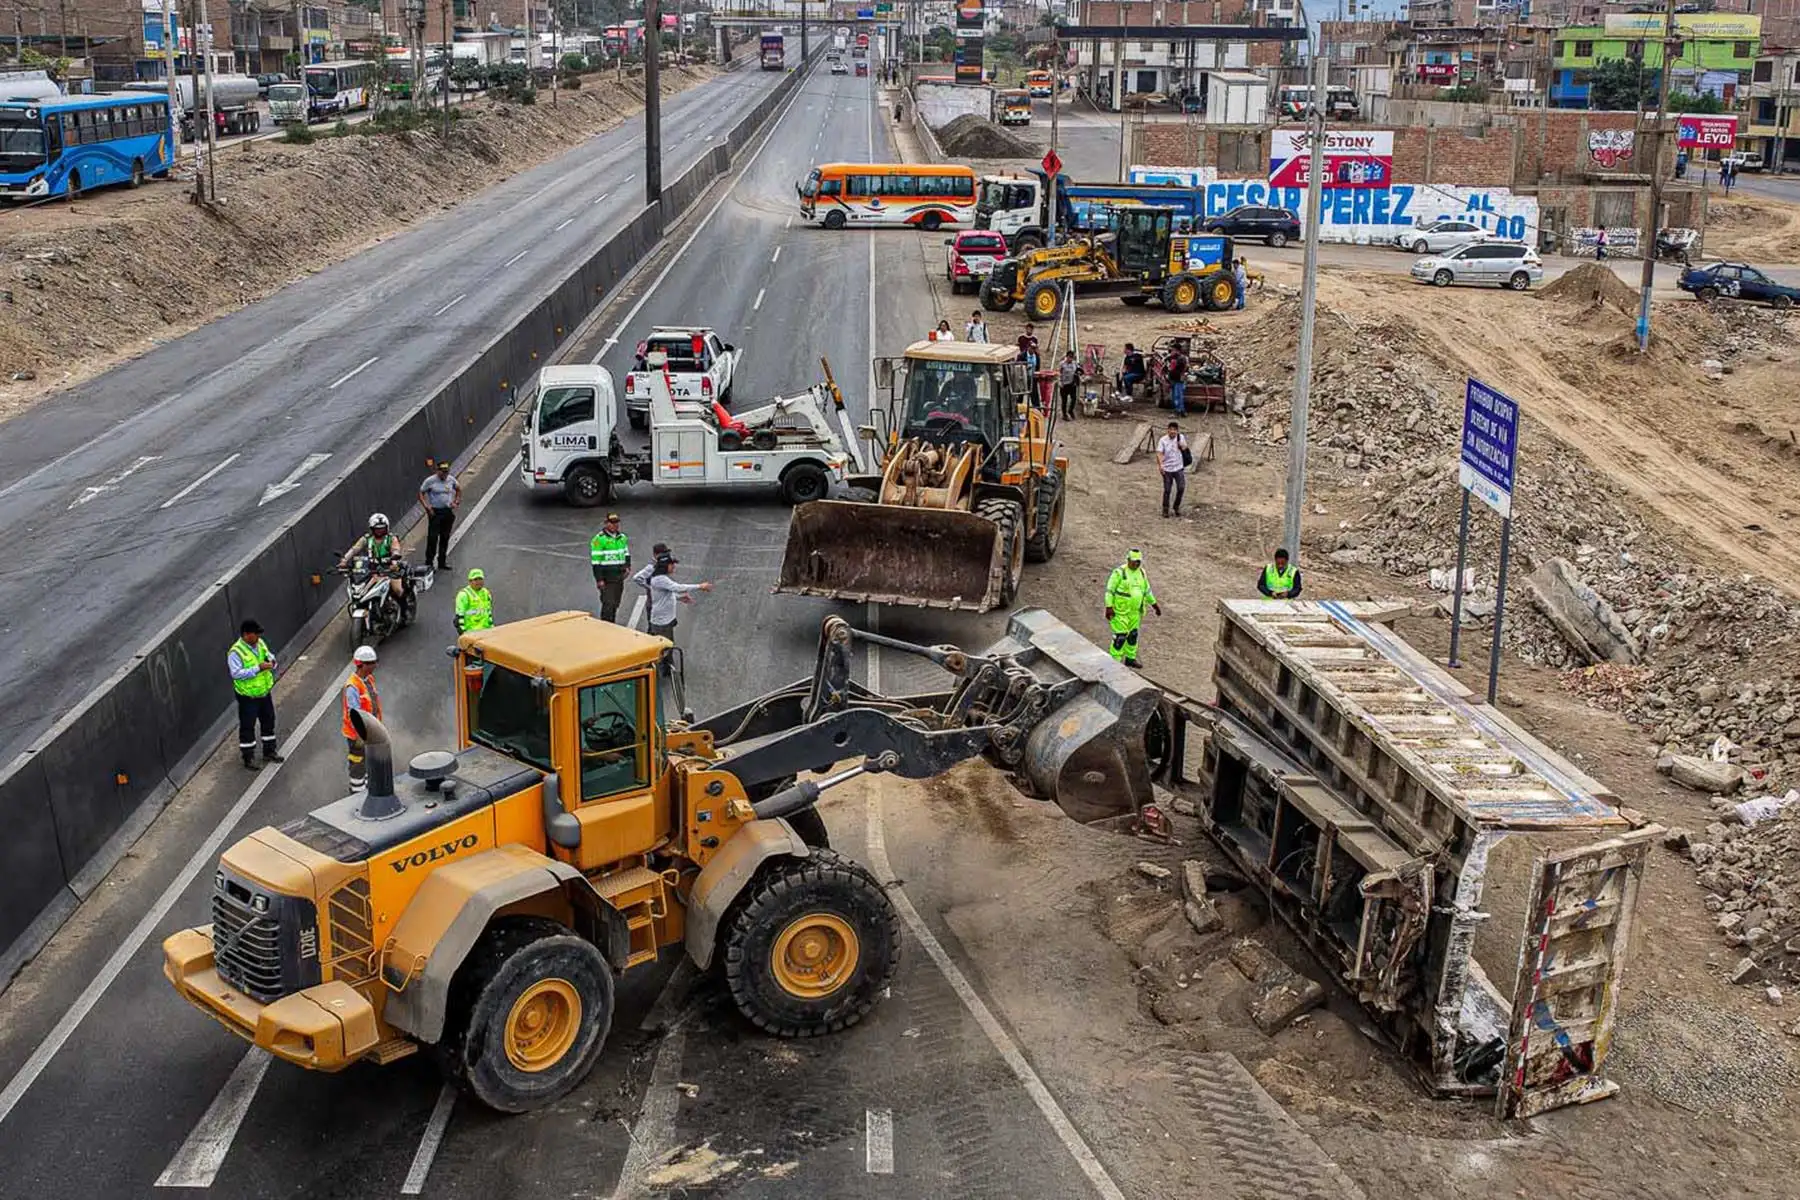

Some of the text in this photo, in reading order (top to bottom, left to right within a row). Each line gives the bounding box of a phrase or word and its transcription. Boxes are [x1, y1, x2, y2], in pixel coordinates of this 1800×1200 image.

[1697, 133, 1732, 144] LEYDI
[1296, 172, 1333, 183] LEDI
[1319, 186, 1415, 225] PEREZ
[1466, 193, 1495, 212] AL
[645, 387, 691, 396] TOTA
[555, 436, 586, 445] LIMA
[389, 834, 479, 874] VOLVO
